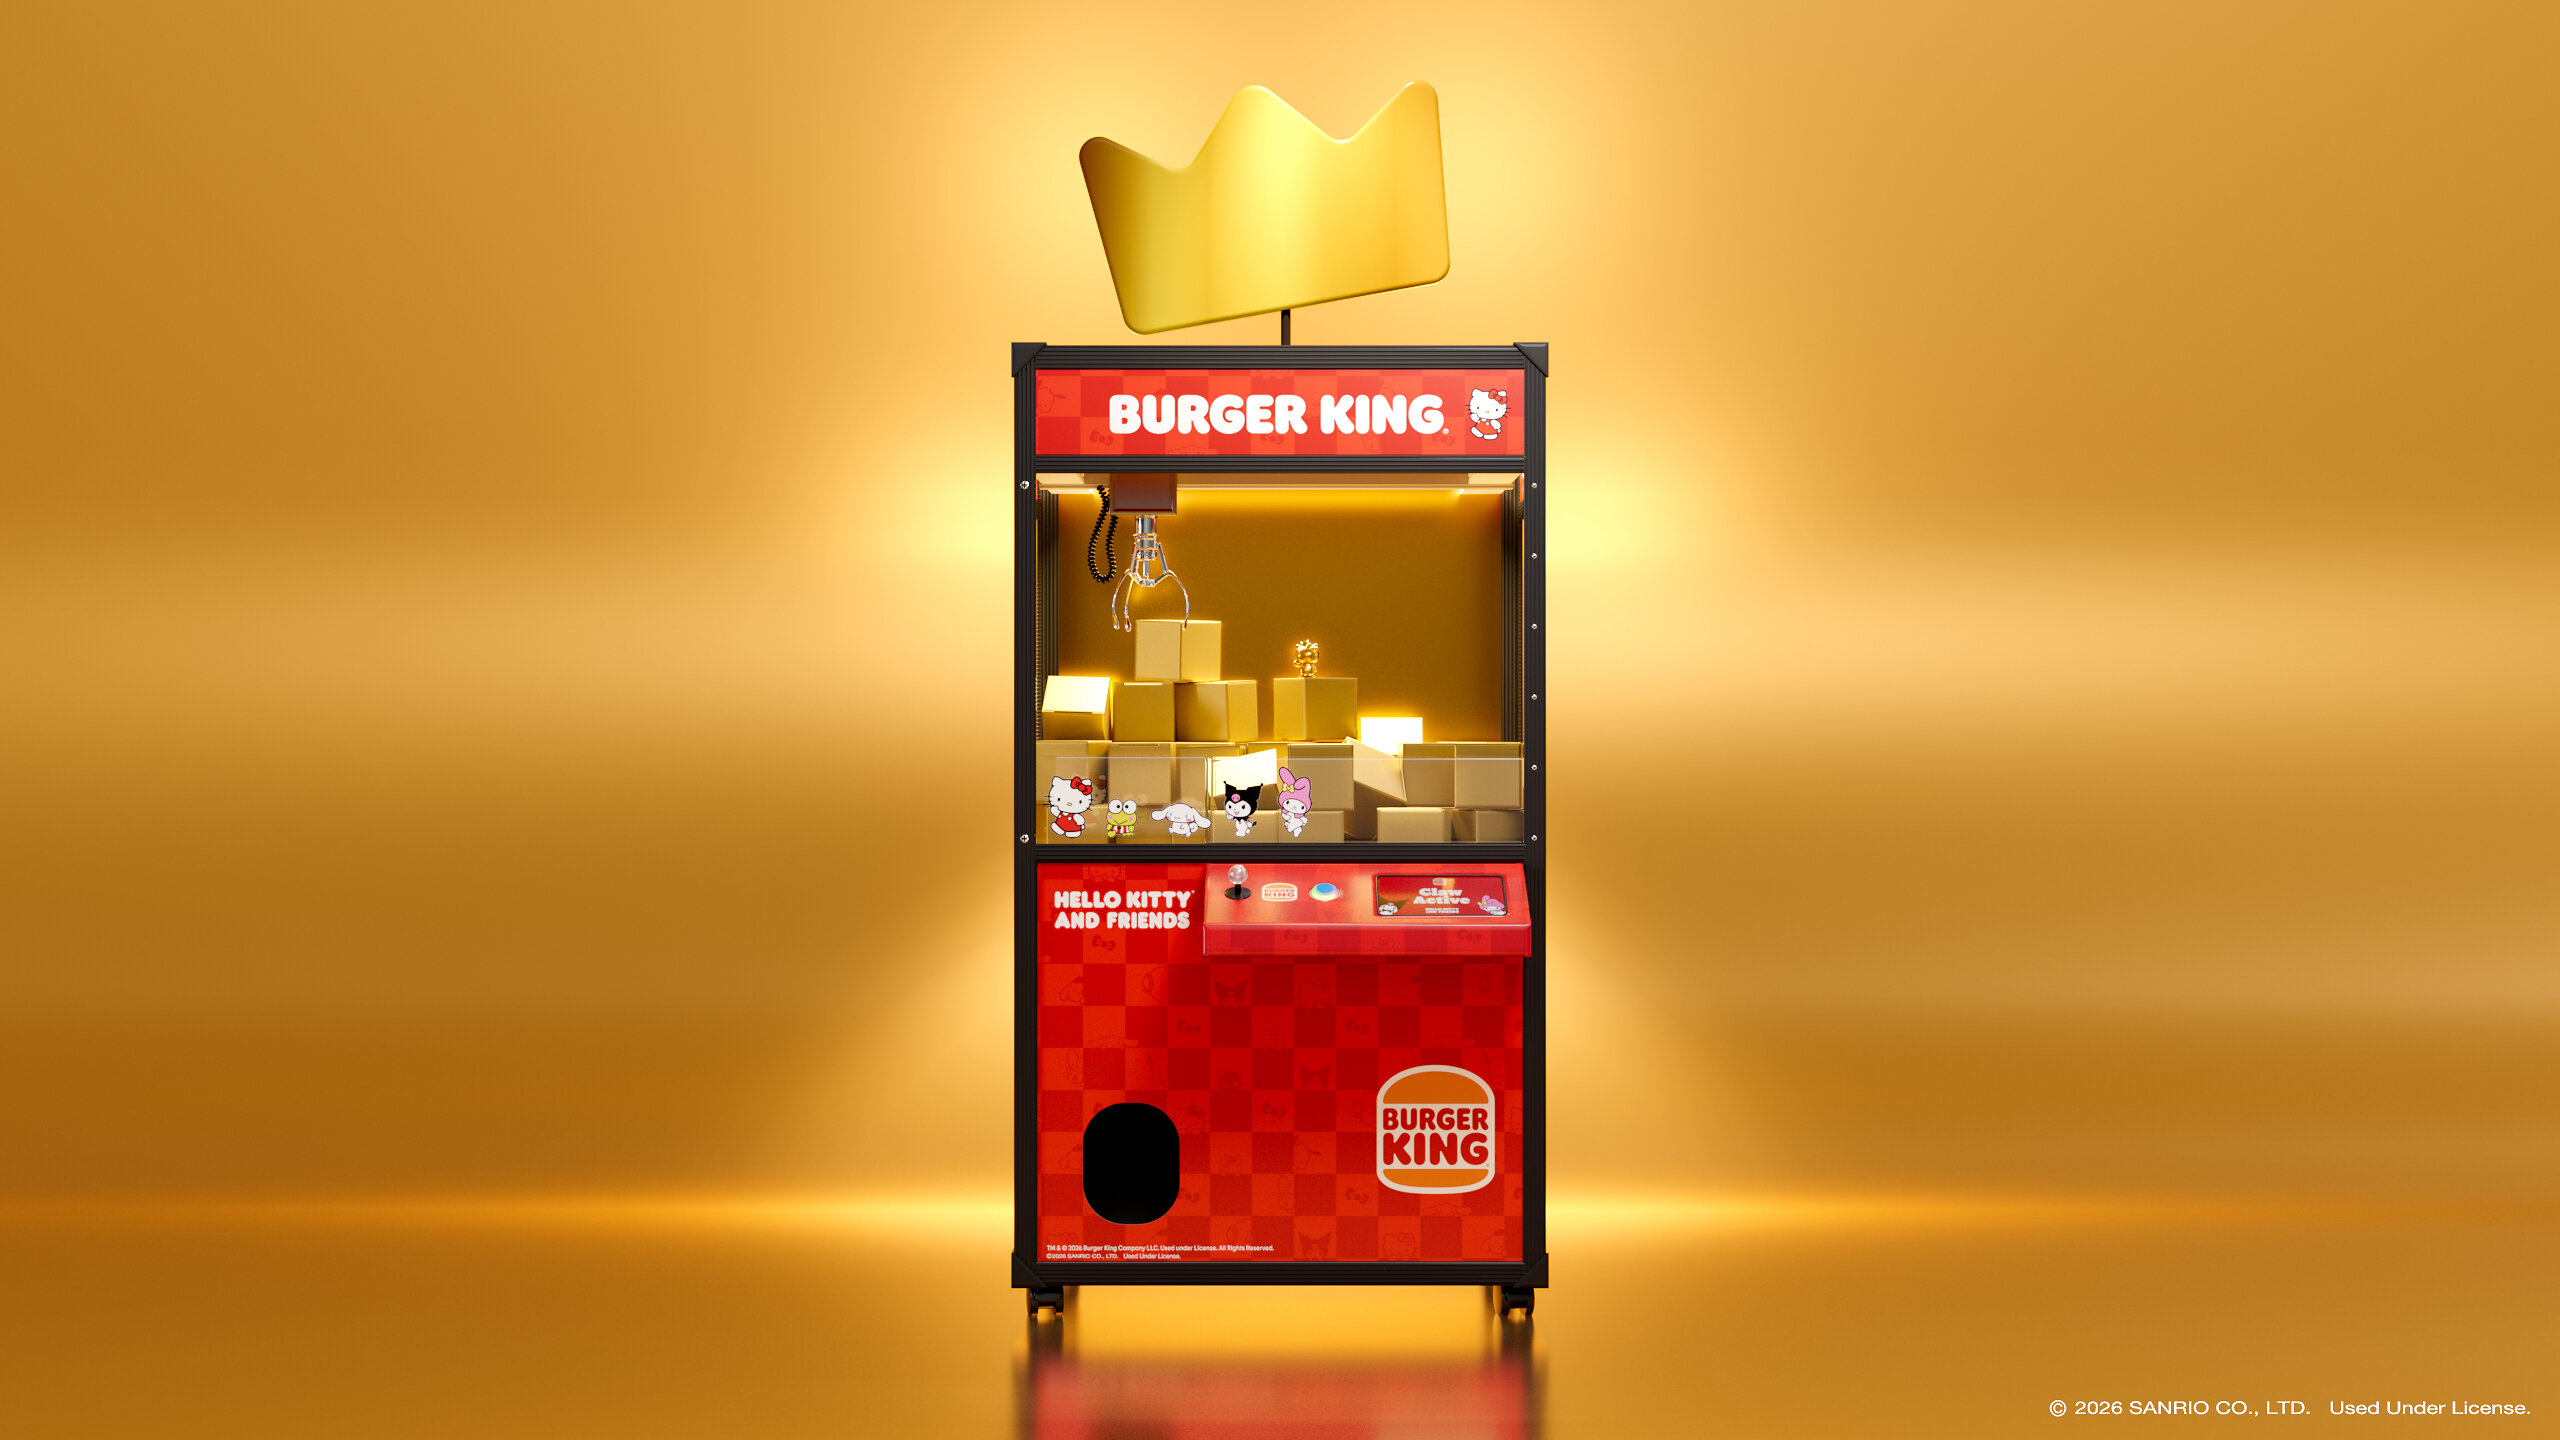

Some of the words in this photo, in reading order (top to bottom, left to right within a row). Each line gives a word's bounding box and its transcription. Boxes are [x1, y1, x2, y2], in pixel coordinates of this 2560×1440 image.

[1109, 394, 1308, 435] BURGER
[1054, 890, 1122, 909] HELLO
[1126, 890, 1191, 909] KITTY
[1413, 895, 1470, 905] Active
[1418, 887, 1463, 896] Claw
[1054, 911, 1100, 929] AND
[1106, 911, 1190, 929] FRIENDS
[1383, 1108, 1489, 1130] BURGER
[1383, 1132, 1489, 1165] KING
